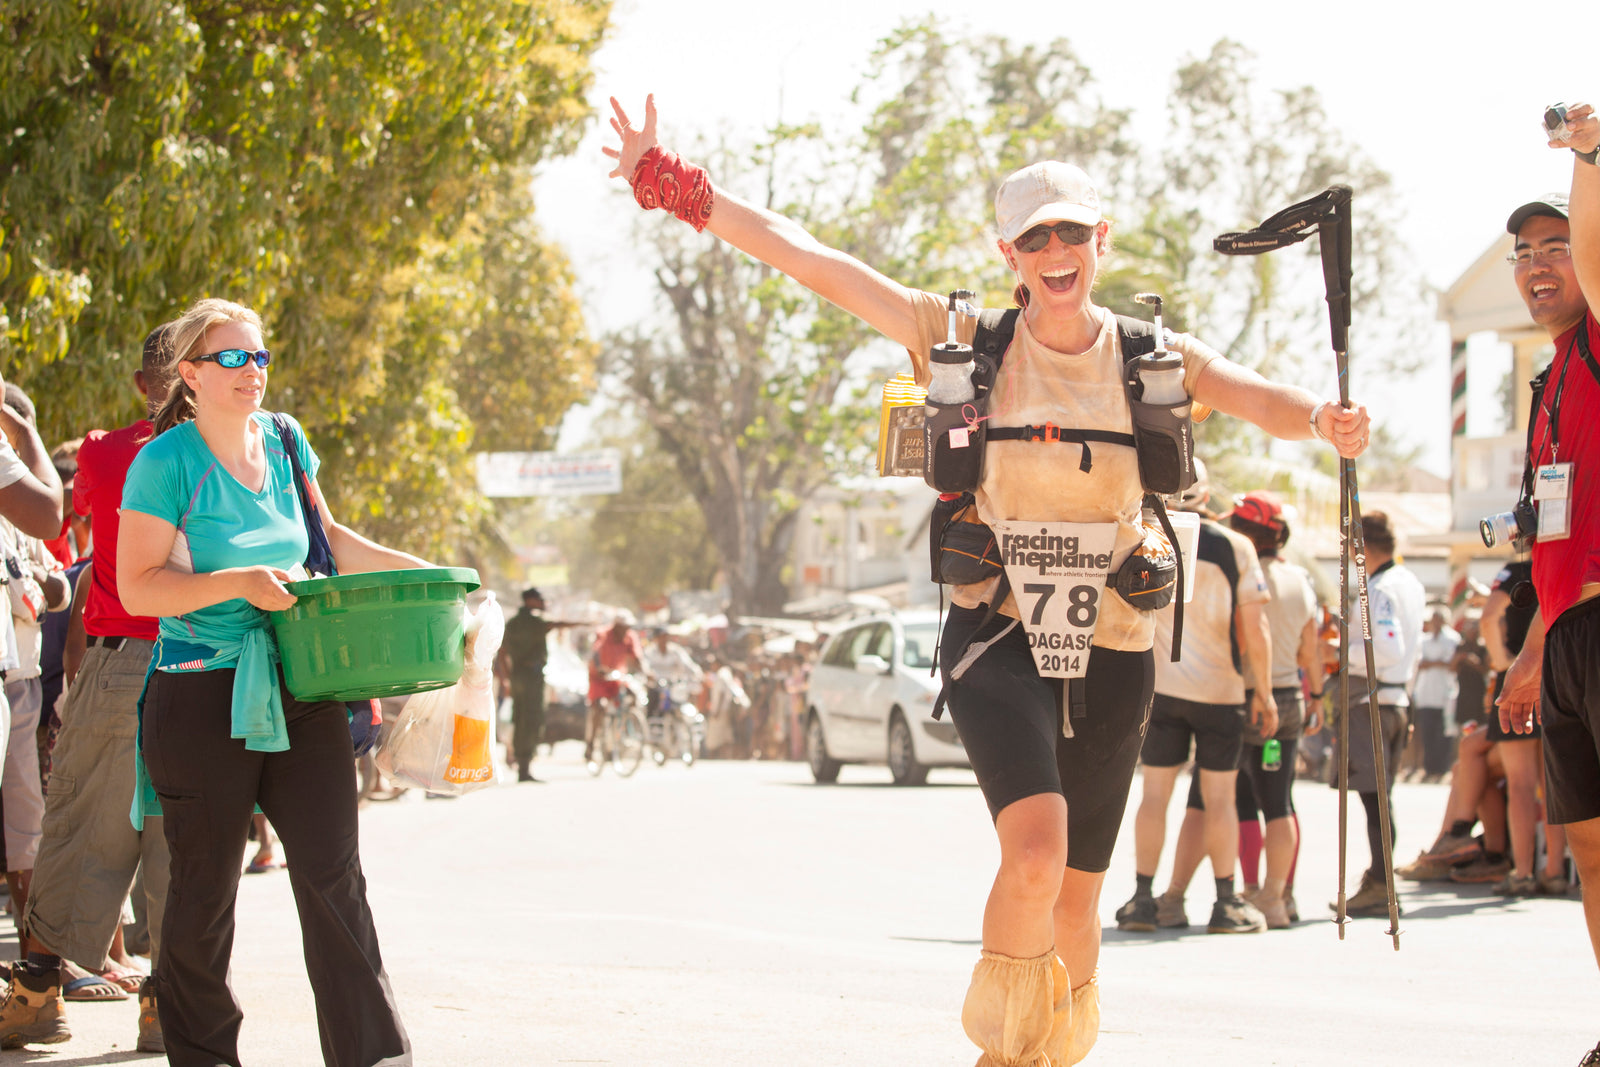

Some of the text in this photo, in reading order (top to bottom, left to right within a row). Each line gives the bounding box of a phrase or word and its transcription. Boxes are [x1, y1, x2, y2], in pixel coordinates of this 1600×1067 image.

[1002, 528, 1079, 555] racing
[1357, 565, 1371, 640] Black Diamond
[1040, 654, 1080, 672] 2014
[449, 766, 489, 781] orange
